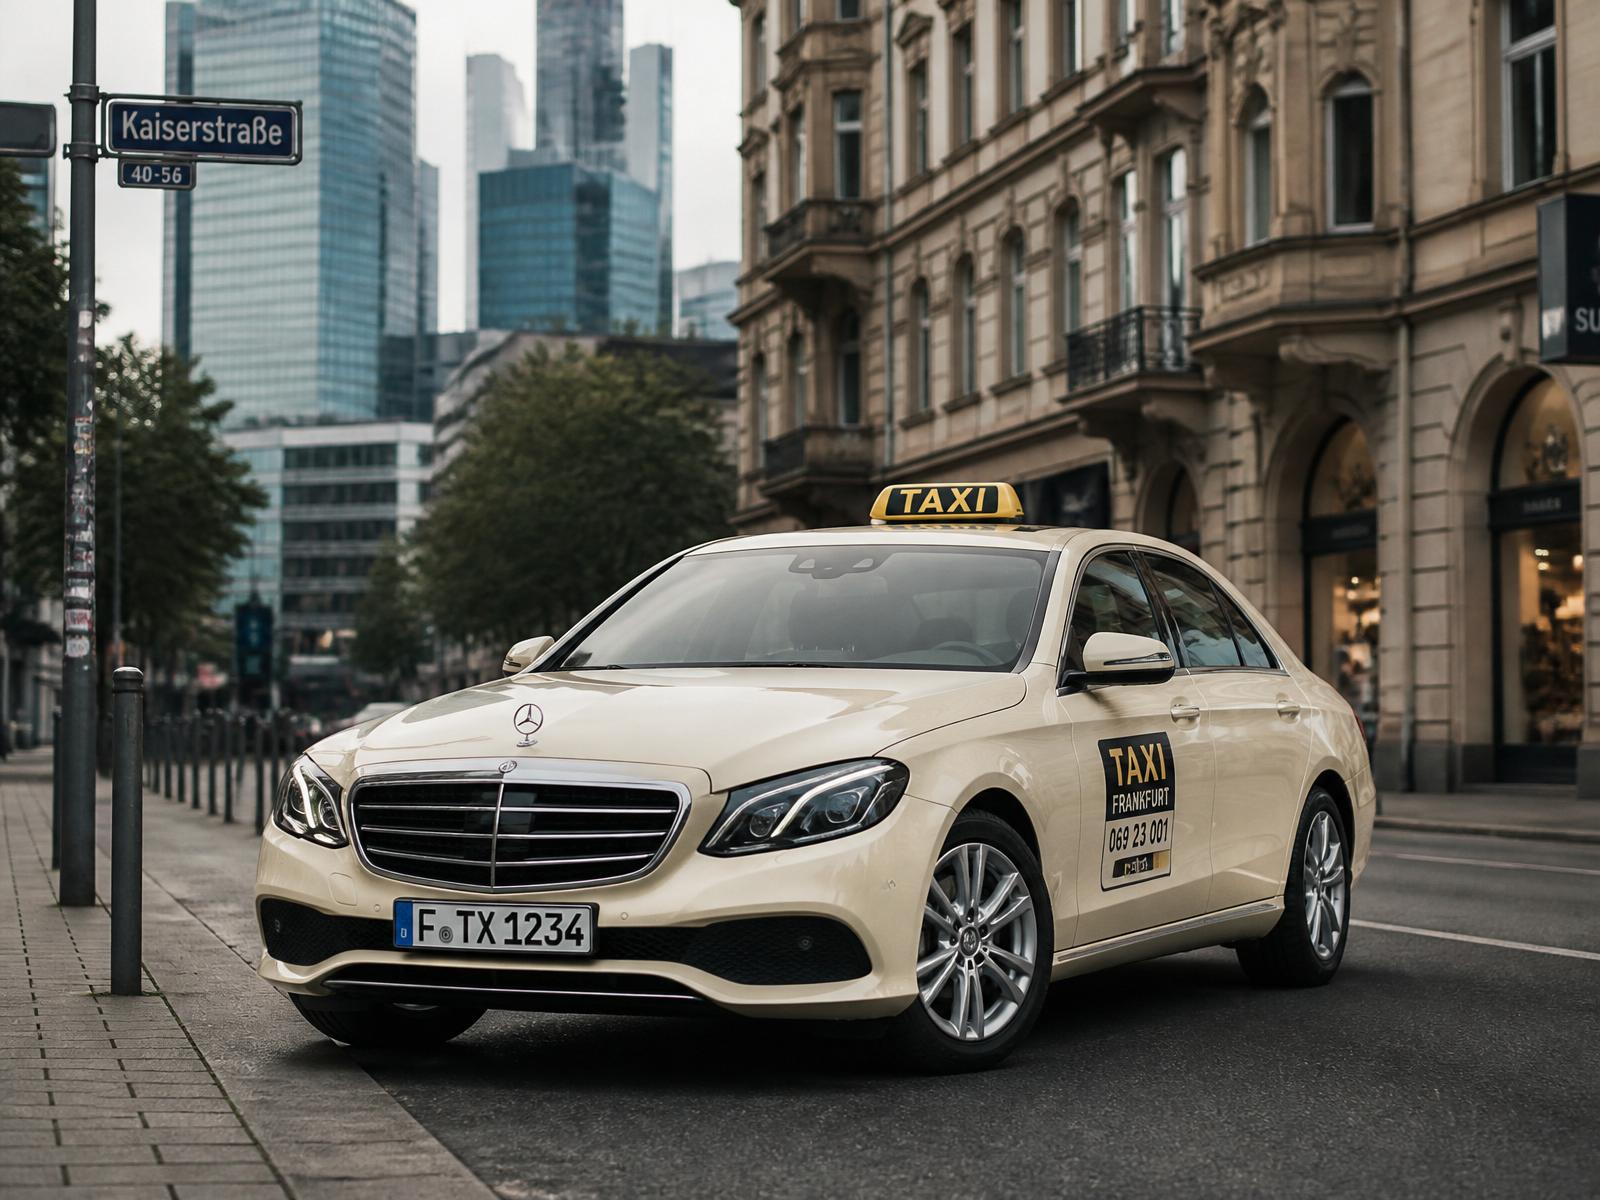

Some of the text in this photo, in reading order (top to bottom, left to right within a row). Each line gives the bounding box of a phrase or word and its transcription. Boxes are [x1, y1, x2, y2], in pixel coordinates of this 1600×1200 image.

[122, 111, 283, 145] Kaiserstraße
[131, 165, 182, 184] 40-56
[900, 487, 986, 514] TAXI
[1109, 742, 1167, 787] TAXI
[1112, 787, 1170, 815] FRANKFURT
[1109, 817, 1169, 853] 069 23 001
[418, 909, 584, 946] F TX 1234
